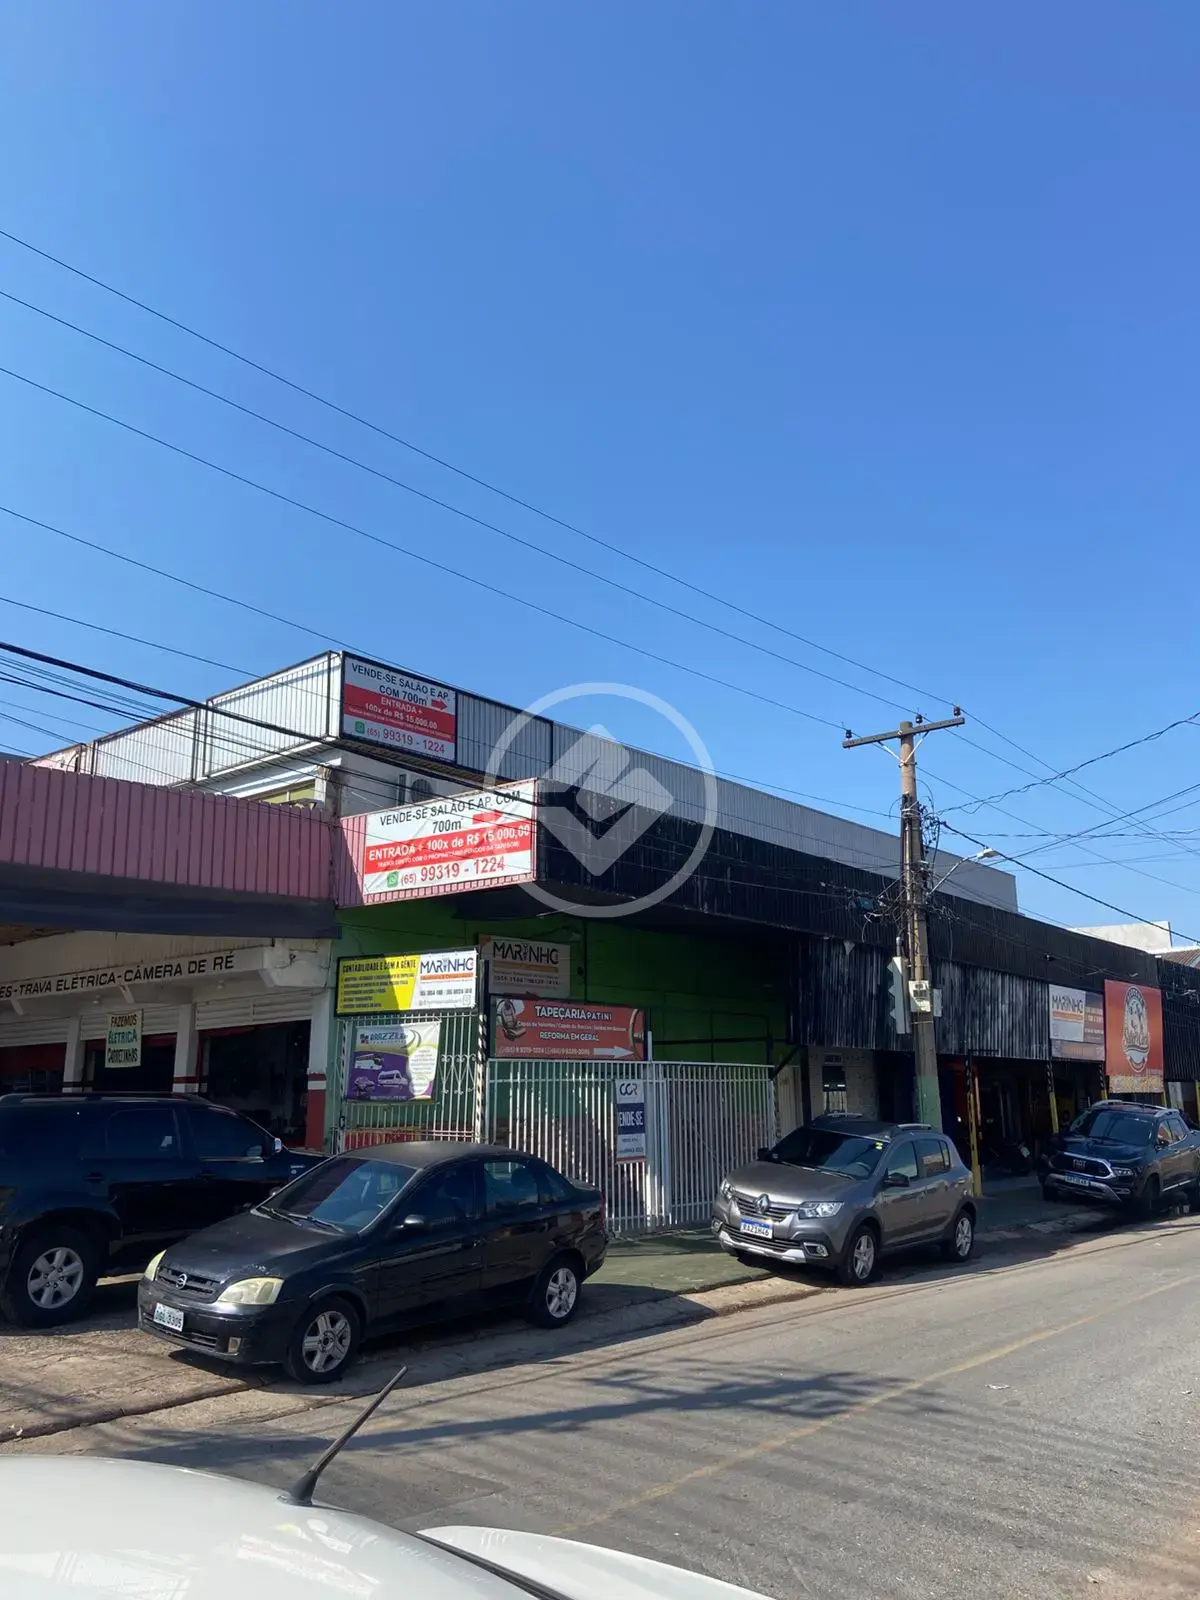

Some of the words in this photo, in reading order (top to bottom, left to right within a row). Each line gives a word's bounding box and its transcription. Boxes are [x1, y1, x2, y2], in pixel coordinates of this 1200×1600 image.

[351, 663, 397, 685] VENDE-SE
[399, 679, 428, 695] SALÃO
[430, 688, 436, 697] E
[437, 690, 450, 701] AP.
[379, 684, 400, 698] COM
[380, 697, 418, 713] ENTRADA
[383, 708, 393, 716] de
[394, 711, 404, 721] R$
[366, 727, 380, 738] (65)
[383, 728, 413, 746] 99319
[423, 739, 445, 753] 1224
[380, 809, 428, 826] VENDE-SE
[430, 800, 465, 817] SALÃO
[467, 799, 475, 810] E
[477, 797, 493, 809] AP.
[495, 790, 521, 805] COM
[369, 843, 416, 861] ENTRADA
[427, 839, 449, 851] 100x
[452, 836, 464, 848] de
[466, 833, 480, 845] R$
[482, 824, 531, 842] 15.000,00
[400, 874, 417, 885] (65)
[420, 862, 460, 882] 99319
[474, 855, 504, 875] 1224
[188, 960, 206, 974] DE
[212, 951, 234, 971] RÉ
[401, 959, 416, 969] GENTE
[111, 1013, 138, 1028] FAZEMOS
[535, 1006, 586, 1020] TAPEÇARIA
[587, 1011, 612, 1021] PATINI
[540, 1031, 570, 1041] REFORMA
[571, 1033, 580, 1041] EM
[580, 1033, 599, 1042] GERAL
[618, 1110, 644, 1128] ENDE-SE
